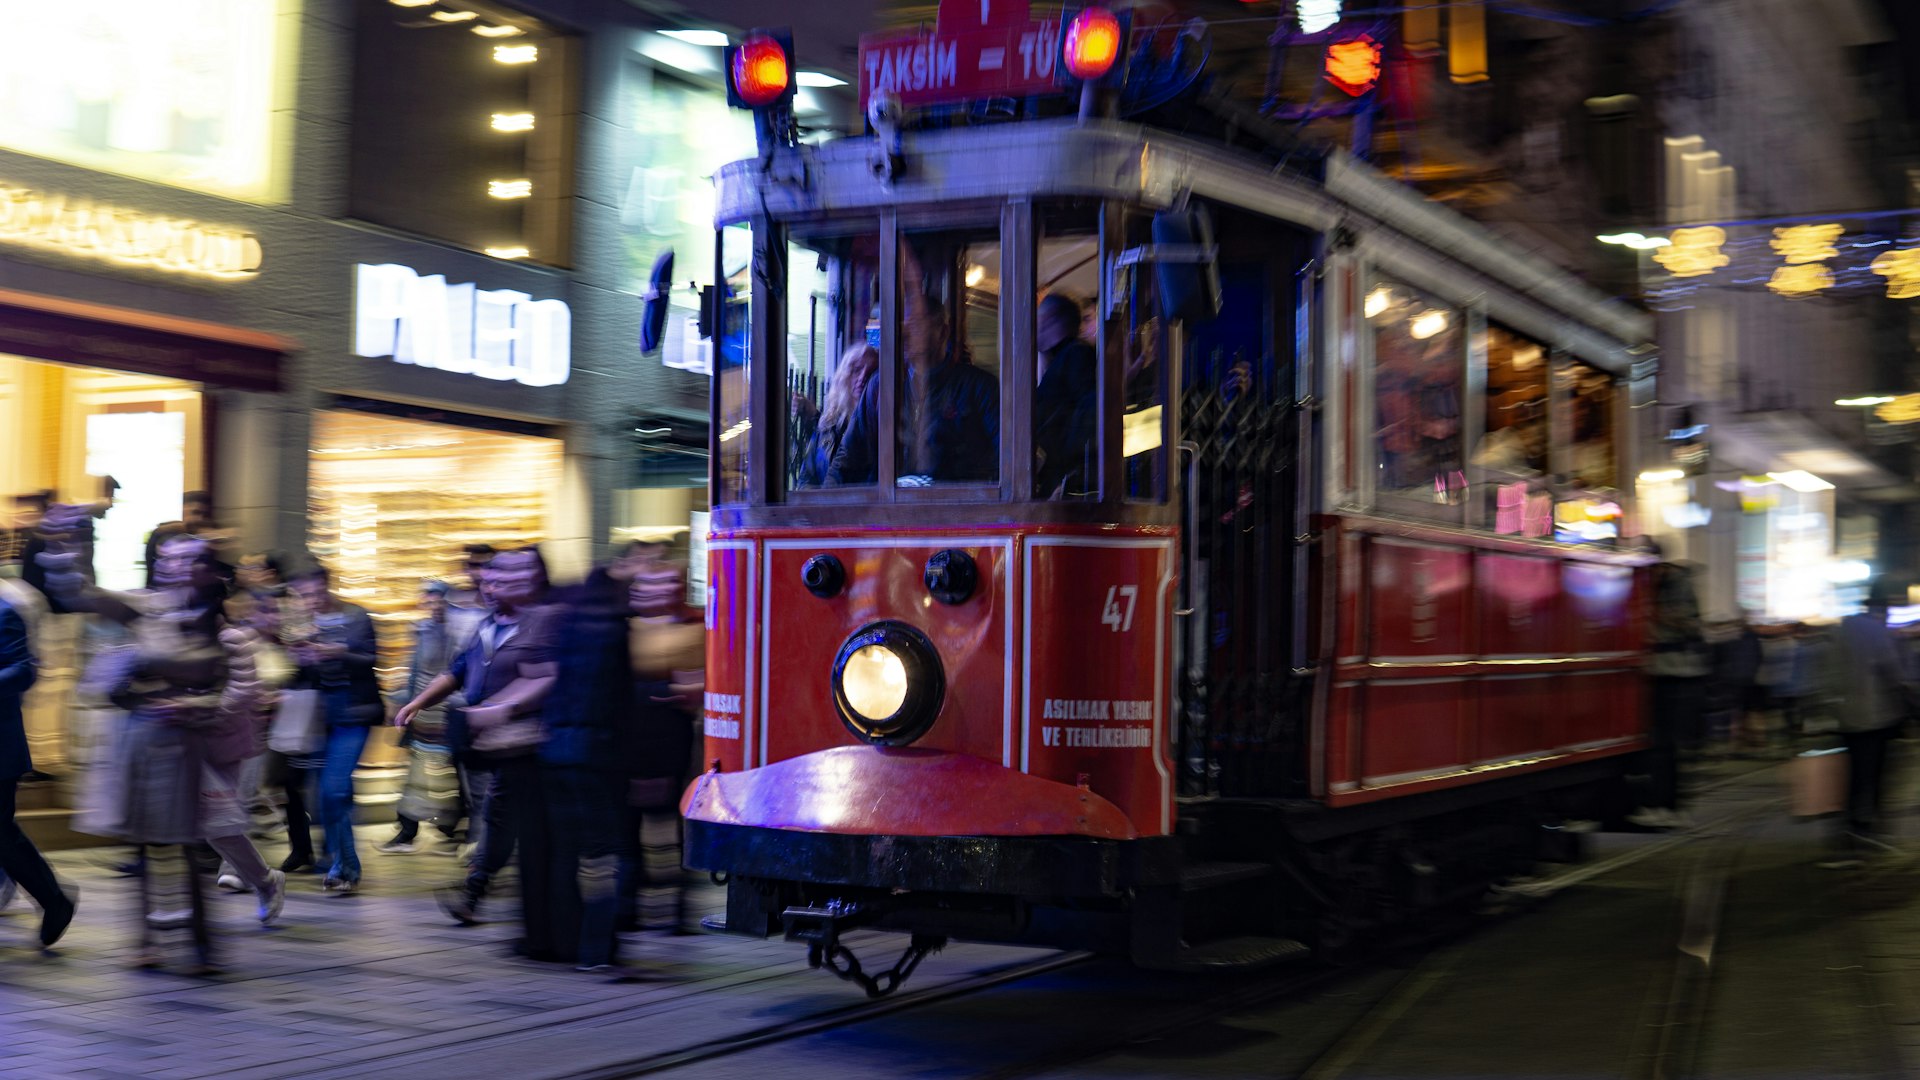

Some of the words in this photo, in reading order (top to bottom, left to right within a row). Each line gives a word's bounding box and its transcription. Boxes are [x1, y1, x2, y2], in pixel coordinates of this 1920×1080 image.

[865, 33, 957, 94] TAKSİM
[1102, 585, 1139, 632] 47
[1043, 698, 1110, 720] ASILMAK
[1112, 700, 1152, 720] YASAK
[1042, 726, 1061, 747] VE
